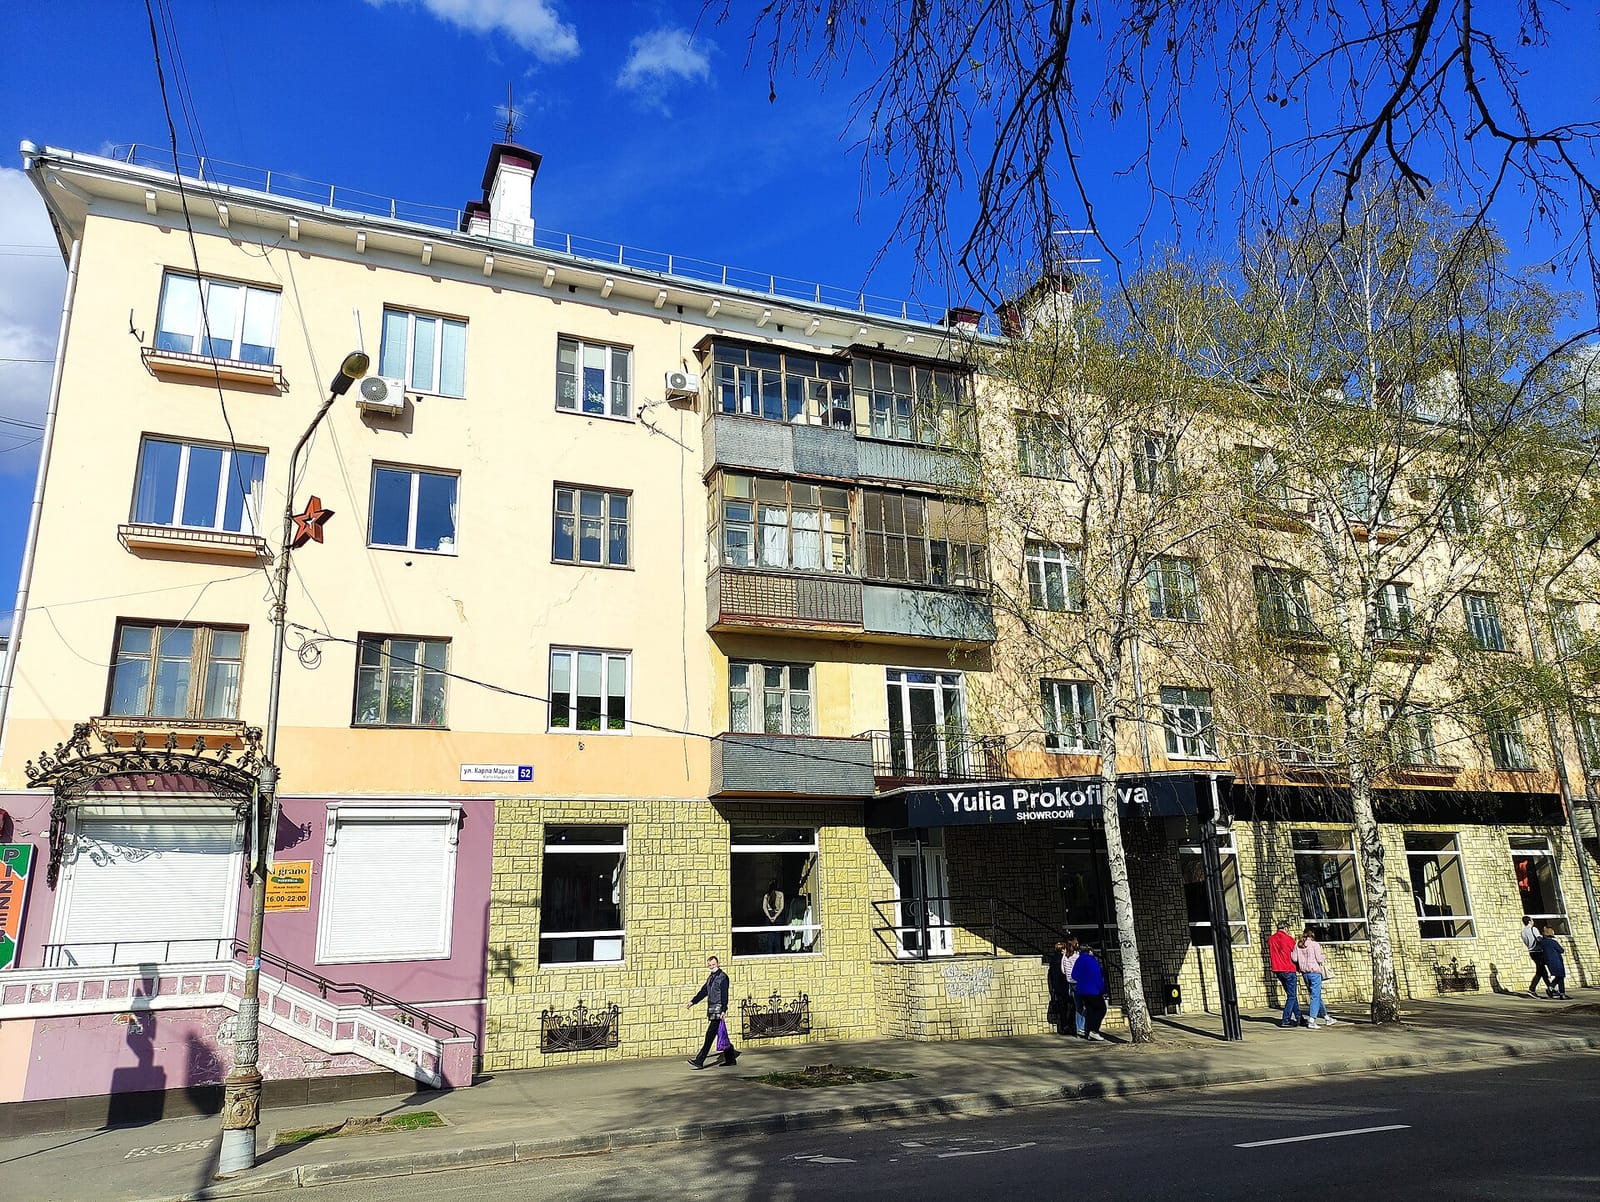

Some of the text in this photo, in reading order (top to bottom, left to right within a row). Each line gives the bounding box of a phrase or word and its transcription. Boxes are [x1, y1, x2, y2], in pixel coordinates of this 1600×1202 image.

[474, 767, 492, 775] Карла
[493, 767, 515, 775] Маркса
[520, 768, 531, 778] 52
[947, 785, 1149, 812] Yulia Prokofiva
[1016, 810, 1074, 820] SHOWROOM
